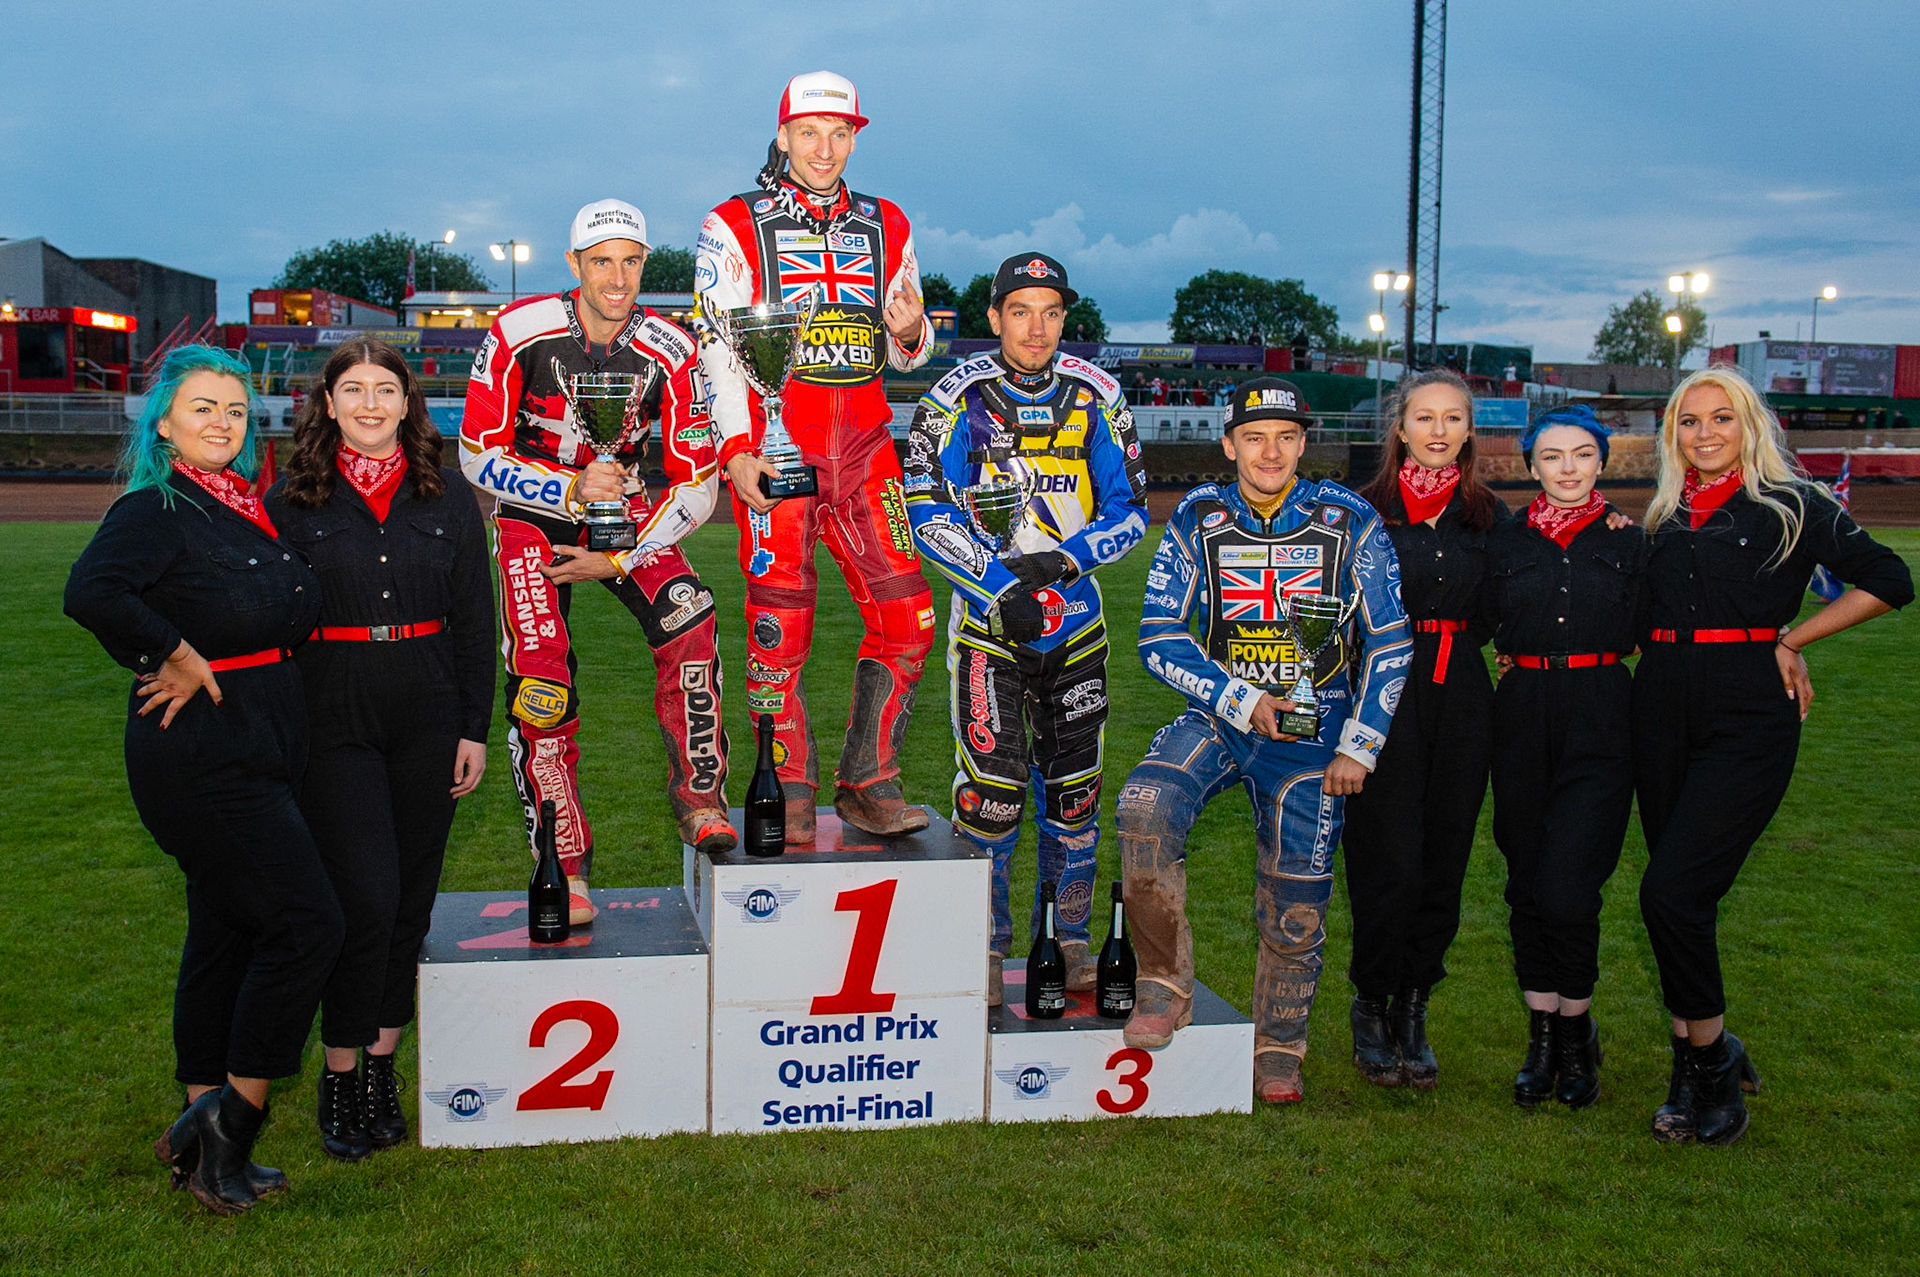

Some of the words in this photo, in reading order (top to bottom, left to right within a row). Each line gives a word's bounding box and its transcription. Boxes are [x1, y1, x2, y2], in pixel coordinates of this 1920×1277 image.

[588, 218, 614, 229] HANSEN
[842, 235, 865, 247] GB
[32, 309, 59, 320] BAR
[1103, 348, 1139, 357] Allied
[1143, 348, 1192, 359] Mobility
[938, 360, 993, 393] ETAB
[1262, 389, 1296, 406] MRC
[1021, 411, 1050, 420] GPA
[479, 458, 561, 505] Nice
[882, 500, 895, 516] BED
[1097, 526, 1143, 560] GPA
[1289, 547, 1318, 559] GB
[523, 546, 551, 615] KRUSE
[508, 558, 540, 651] HANSEN
[539, 619, 557, 639] &
[1231, 645, 1300, 662] POWE
[1165, 661, 1215, 700] MRC
[523, 691, 564, 712] HELLA
[774, 720, 797, 732] amily
[537, 752, 555, 801] SERVICE
[1121, 787, 1157, 801] JCB
[1314, 819, 1330, 867] PLANT
[748, 896, 774, 911] FIM
[809, 879, 898, 1015] 1
[760, 1015, 864, 1046] Grand
[876, 1013, 938, 1041] Prix
[516, 999, 619, 1111] 2
[778, 1054, 920, 1088] Qualifier
[1020, 1073, 1045, 1089] FIM
[1096, 1048, 1153, 1113] 3
[453, 1095, 482, 1110] FIM
[763, 1091, 933, 1126] Semi-Final
